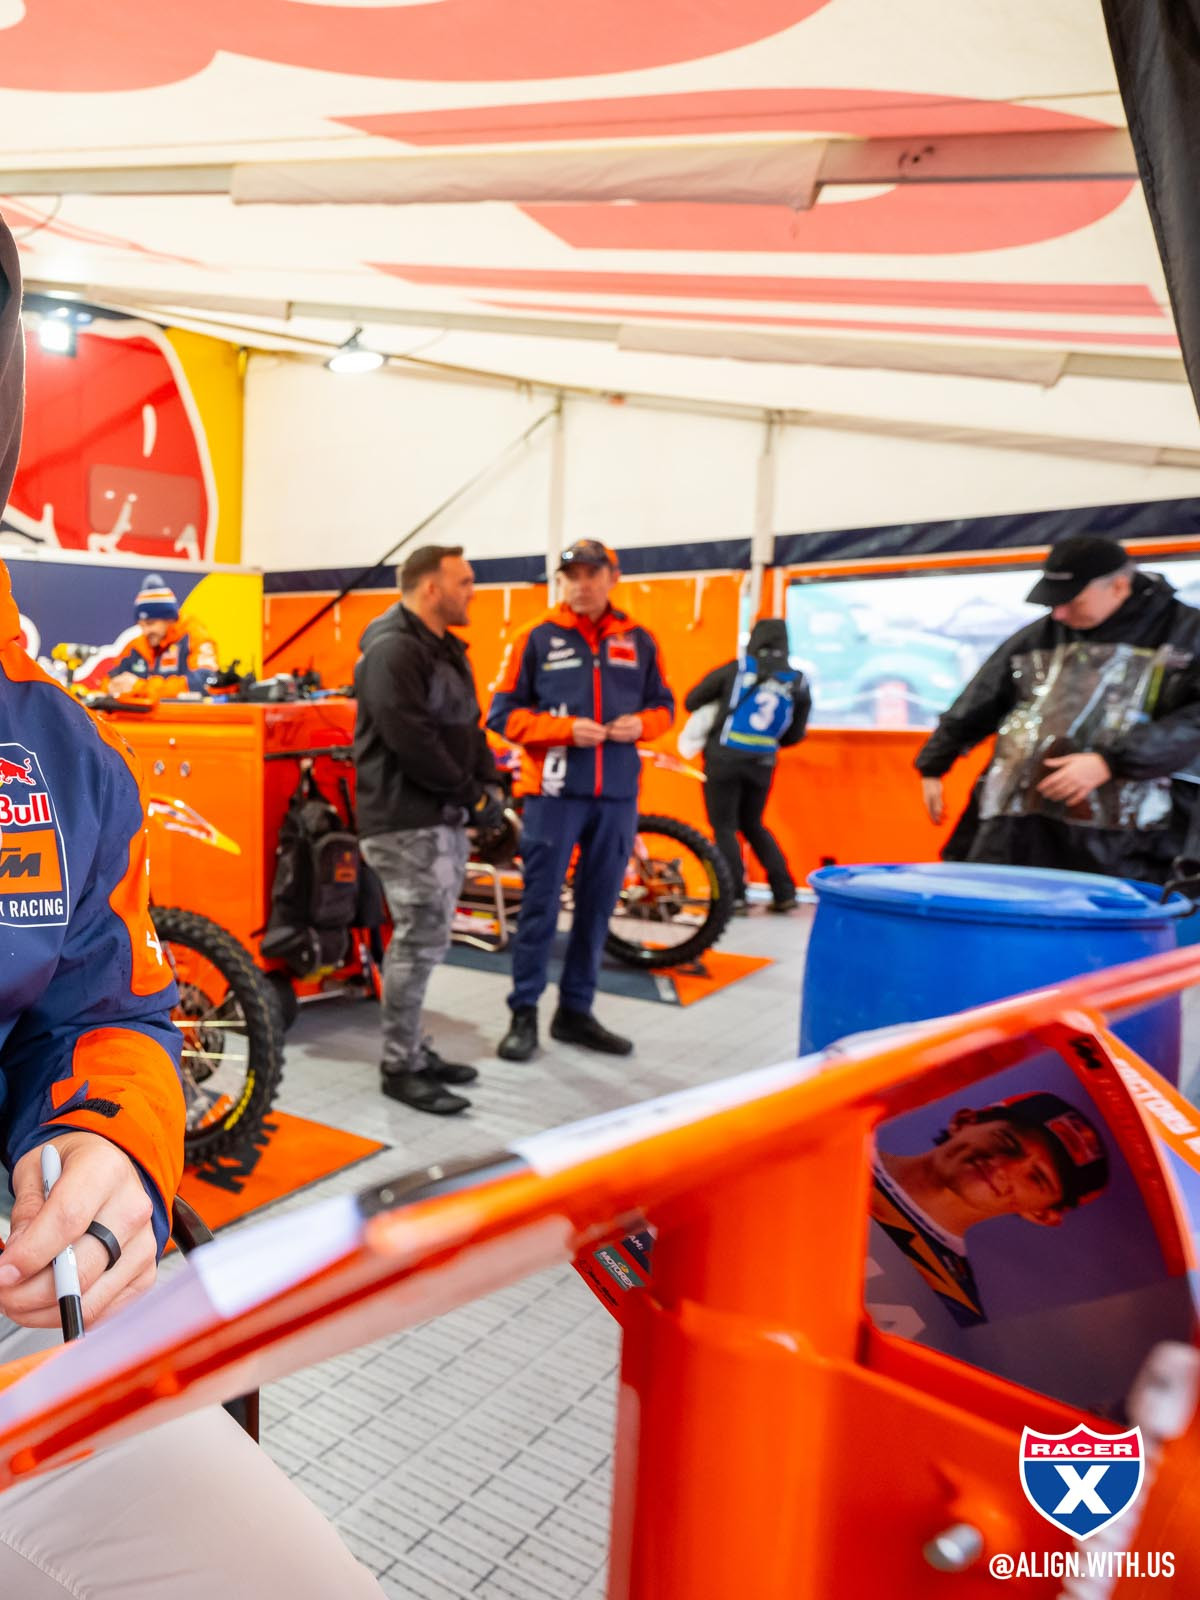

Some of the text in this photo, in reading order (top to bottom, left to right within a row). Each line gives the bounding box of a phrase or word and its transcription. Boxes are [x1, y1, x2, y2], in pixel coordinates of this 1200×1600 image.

[749, 692, 780, 732] 3
[9, 898, 64, 918] RACING
[599, 1250, 635, 1289] MOTOREX
